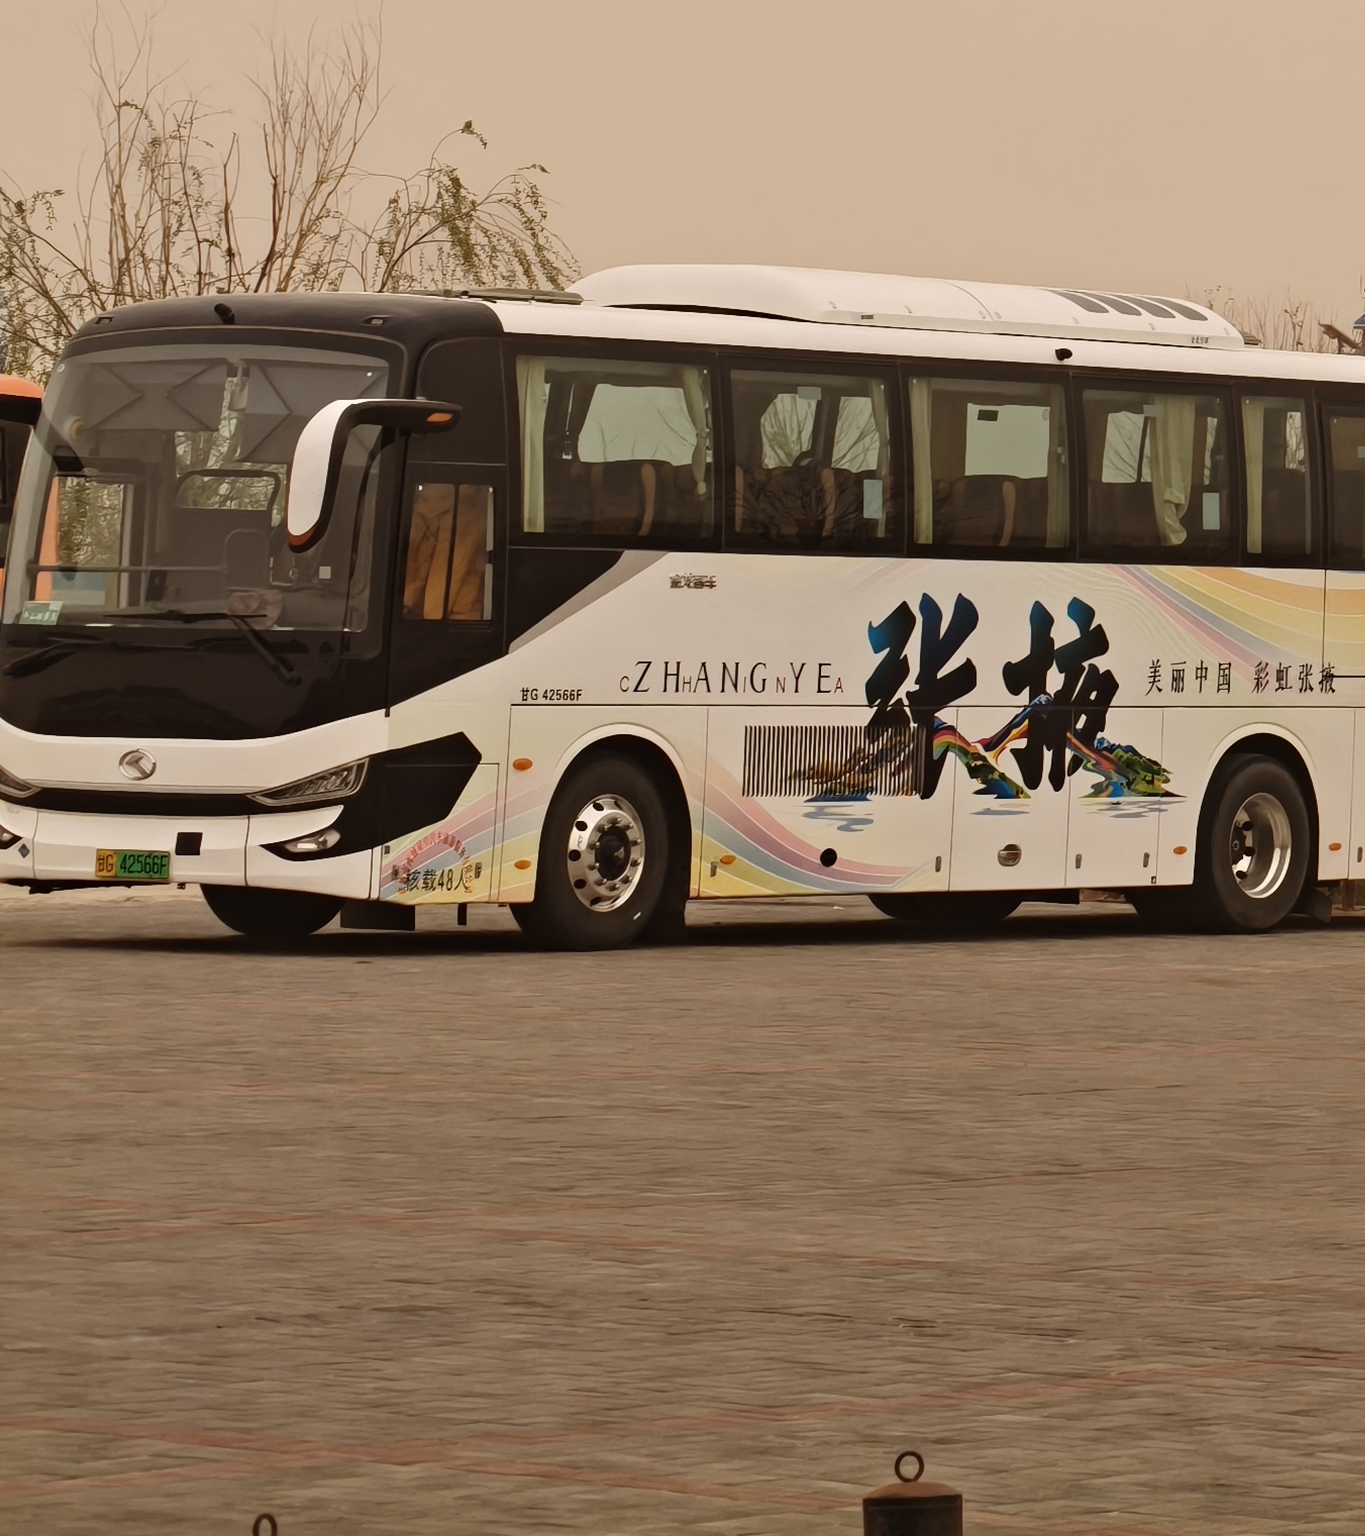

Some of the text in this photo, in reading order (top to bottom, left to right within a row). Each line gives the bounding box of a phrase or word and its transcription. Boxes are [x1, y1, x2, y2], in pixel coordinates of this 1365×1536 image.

[1145, 659, 1336, 696] 美丽中国 彩虹张掖
[542, 688, 583, 702] 42566F
[865, 593, 1119, 800] 张掖
[120, 854, 169, 875] 42566F
[407, 868, 468, 892] 核载48人
